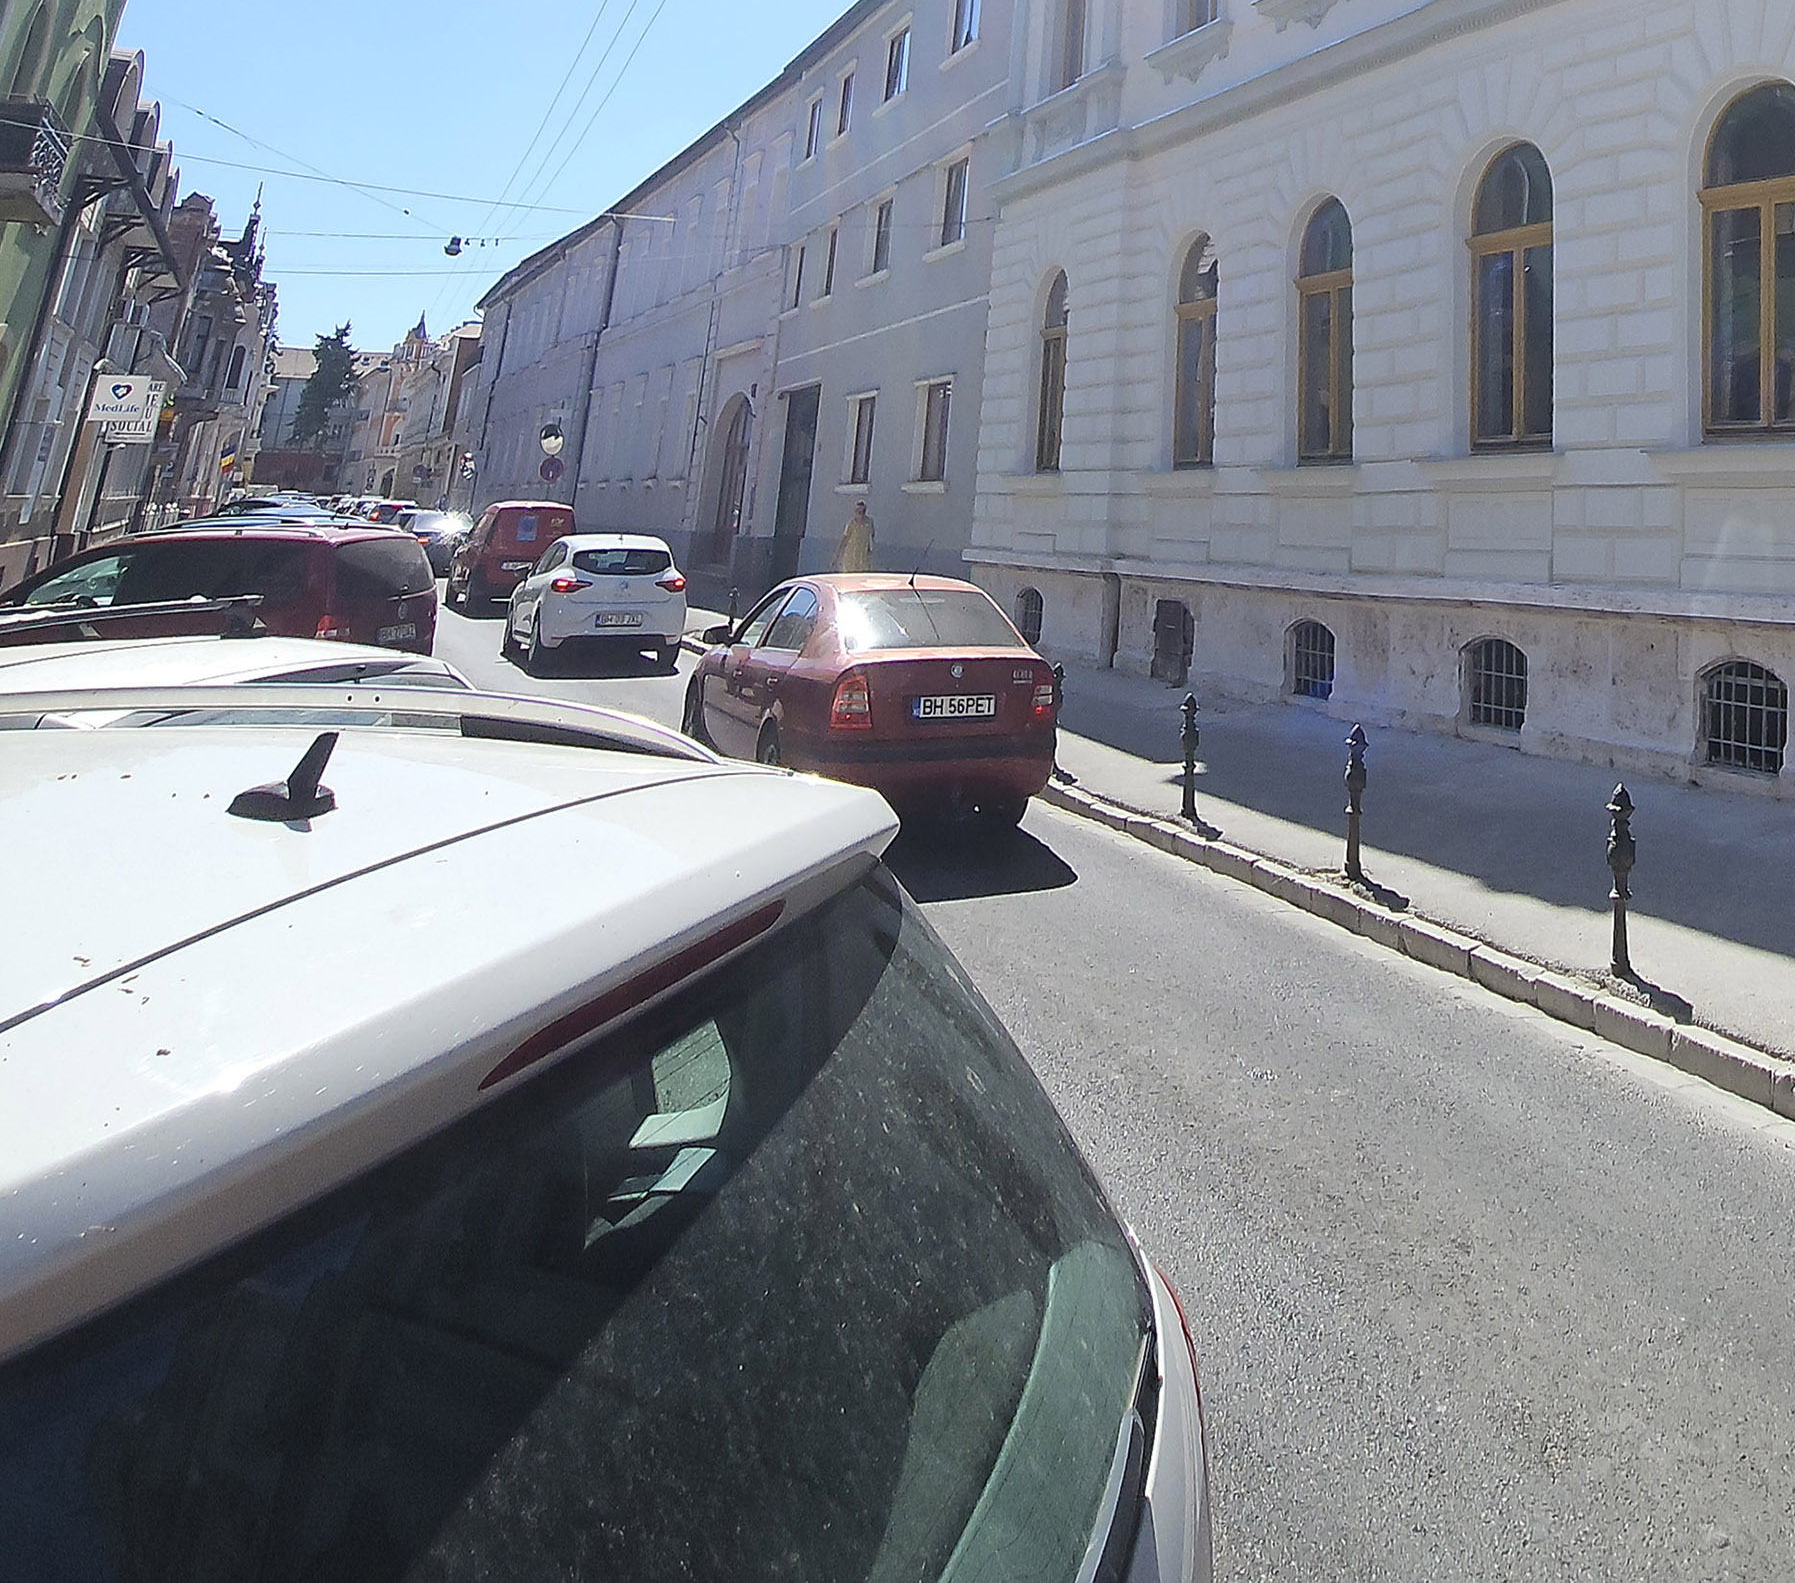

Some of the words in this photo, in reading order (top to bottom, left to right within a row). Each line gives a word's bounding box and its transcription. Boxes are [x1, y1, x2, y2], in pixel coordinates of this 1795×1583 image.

[95, 403, 140, 413] MedLife
[110, 420, 152, 432] SOCIAL
[922, 698, 944, 715] BH
[948, 697, 994, 714] 56PET
